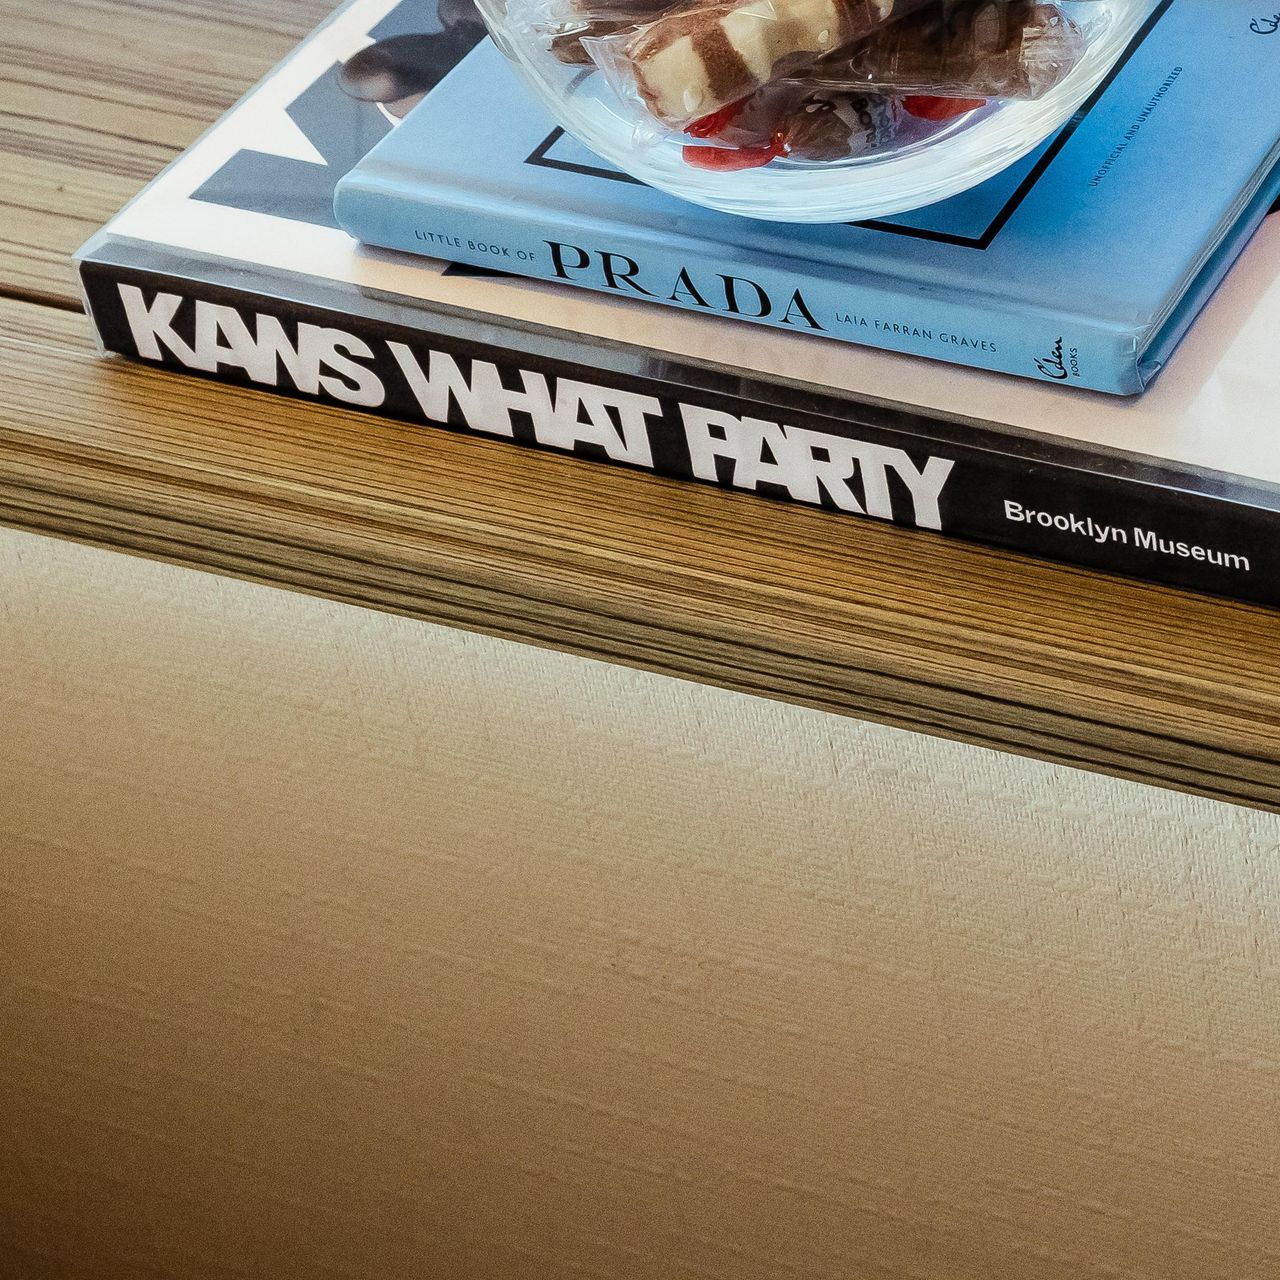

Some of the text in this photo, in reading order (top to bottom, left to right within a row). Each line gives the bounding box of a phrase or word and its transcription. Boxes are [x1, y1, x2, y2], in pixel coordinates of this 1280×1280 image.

[1088, 66, 1183, 187] UNOFFICIAL AND UNAUTHORIZED
[414, 230, 997, 353] LITTLE BOOK OF PRADA LAIA FARRAN GRAVES
[1072, 347, 1081, 377] BOOKS
[386, 340, 665, 469] WHAT
[678, 402, 957, 532] PARTY
[1003, 499, 1251, 572] Brooklyn Museum
